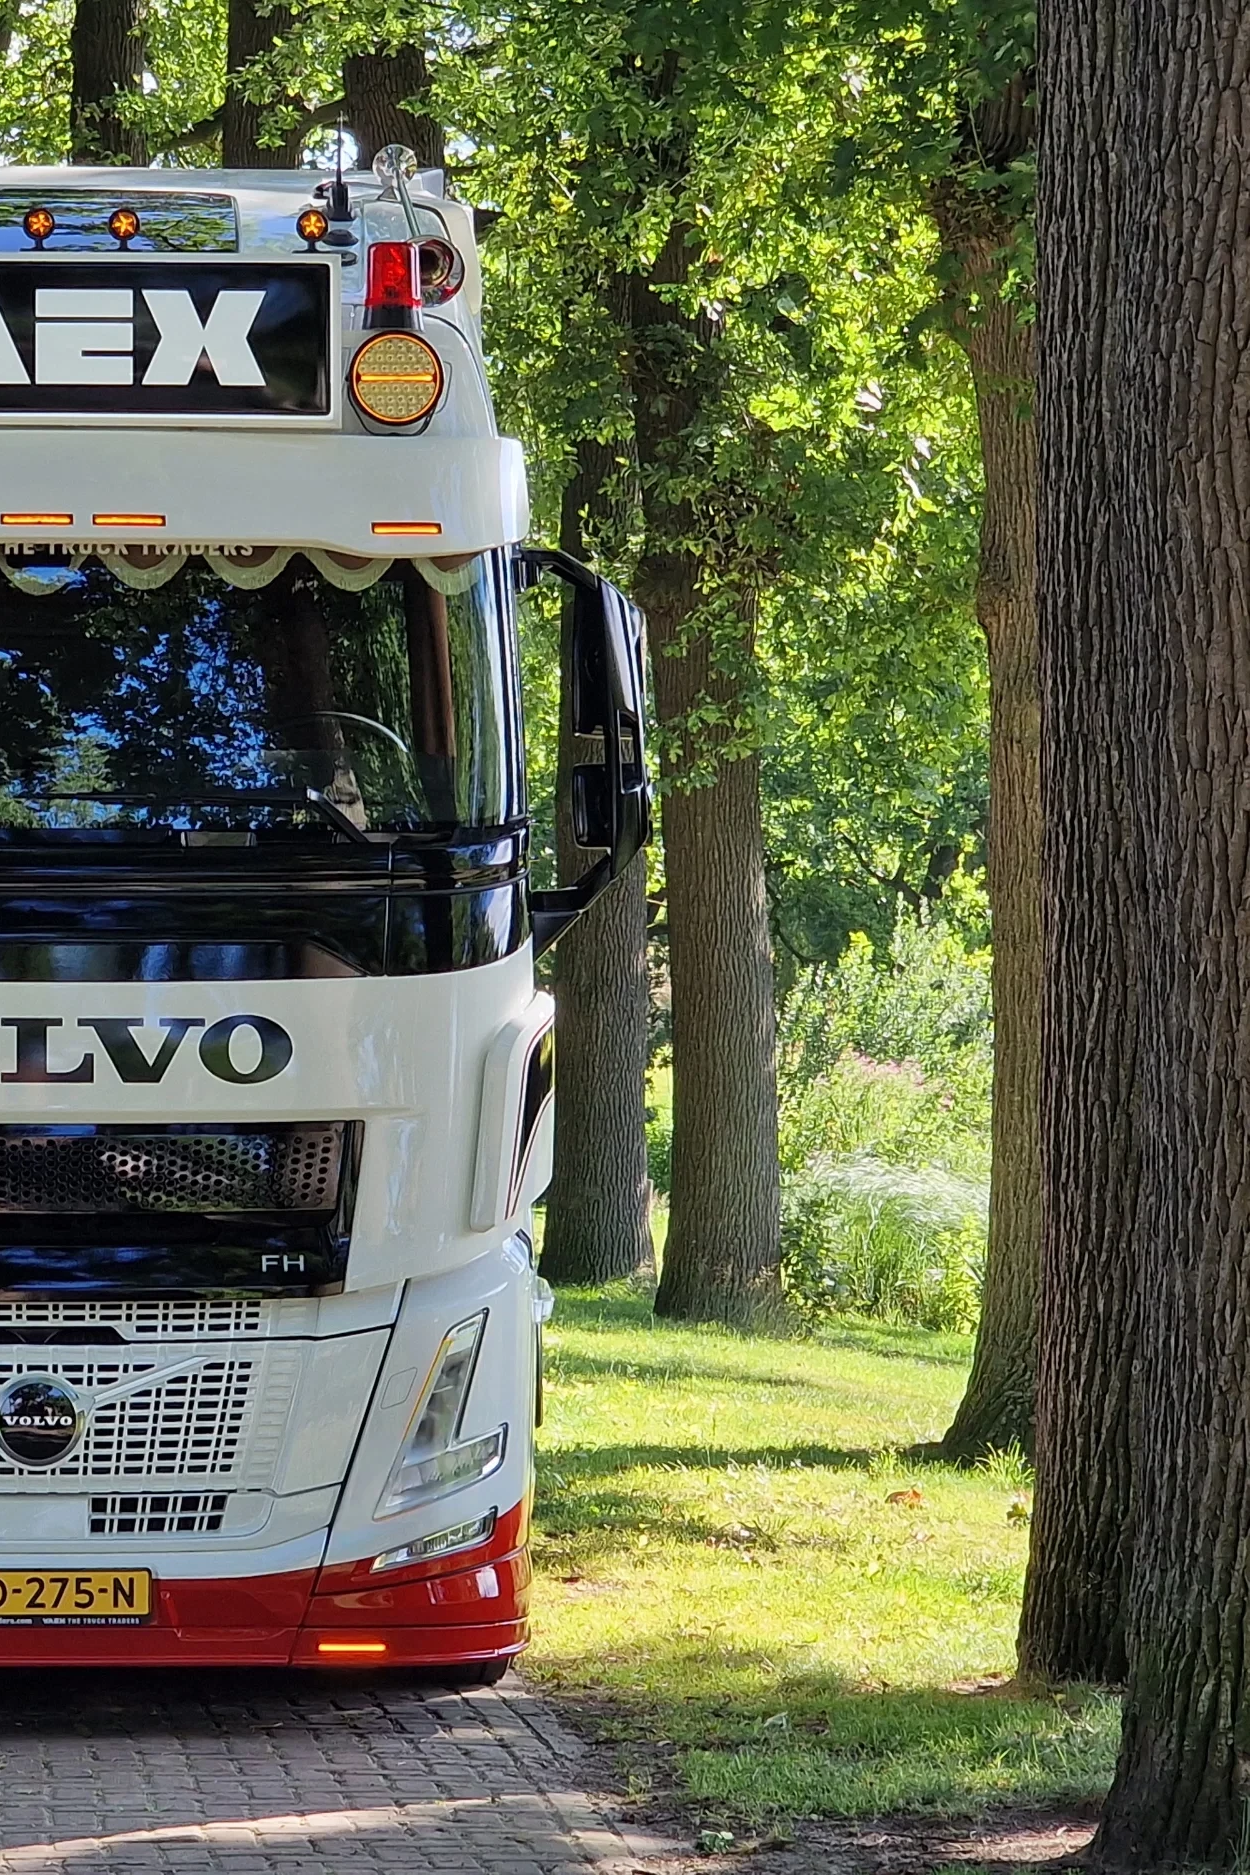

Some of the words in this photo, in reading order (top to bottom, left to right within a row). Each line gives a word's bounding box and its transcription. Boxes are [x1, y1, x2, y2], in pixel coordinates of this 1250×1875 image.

[261, 1254, 305, 1273] FH
[2, 1415, 73, 1426] VOLVO
[68, 1617, 81, 1625] THE
[108, 1617, 140, 1625] TRADERS
